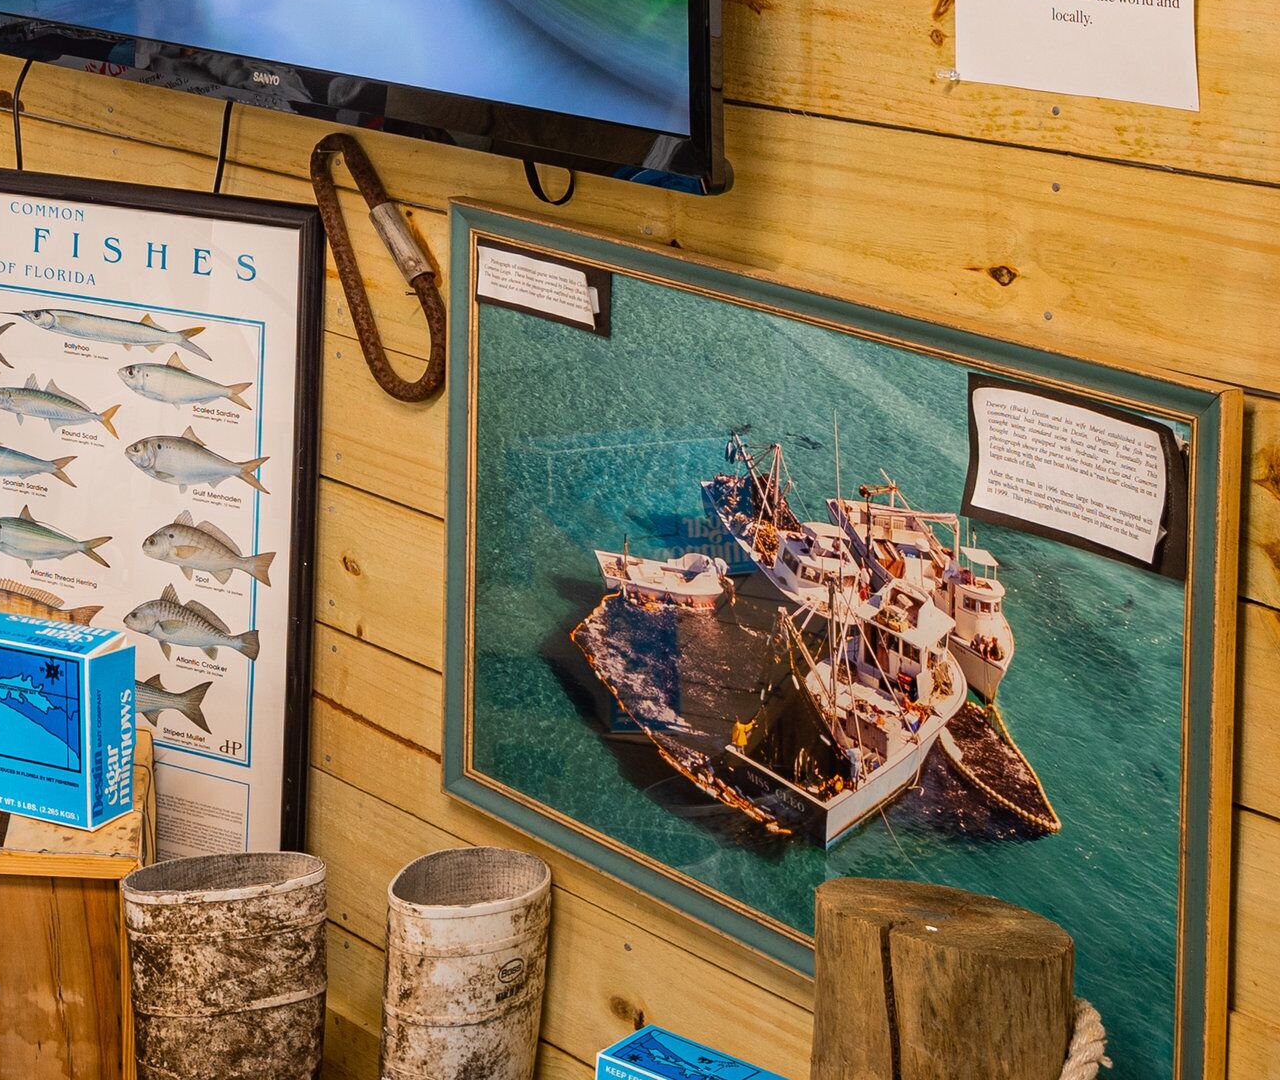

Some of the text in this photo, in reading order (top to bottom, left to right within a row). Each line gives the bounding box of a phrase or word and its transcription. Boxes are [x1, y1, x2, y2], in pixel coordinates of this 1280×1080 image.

[1052, 7, 1092, 27] locally.
[252, 72, 280, 86] SANYO
[10, 201, 84, 221] COMMON
[33, 226, 258, 282] FISHES
[24, 264, 96, 286] FLORIDA
[64, 342, 90, 352] Ballyhoo
[192, 405, 240, 419] Scaled Sardine
[61, 428, 98, 440] Round Scad
[192, 488, 242, 503] Gulf Menhaden
[195, 574, 210, 584] Spot
[175, 655, 227, 672] Atlantic Croaker
[163, 727, 205, 742] Striped Mullet
[120, 688, 132, 805] minnows
[104, 745, 119, 806] cigar
[746, 770, 770, 792] MISS
